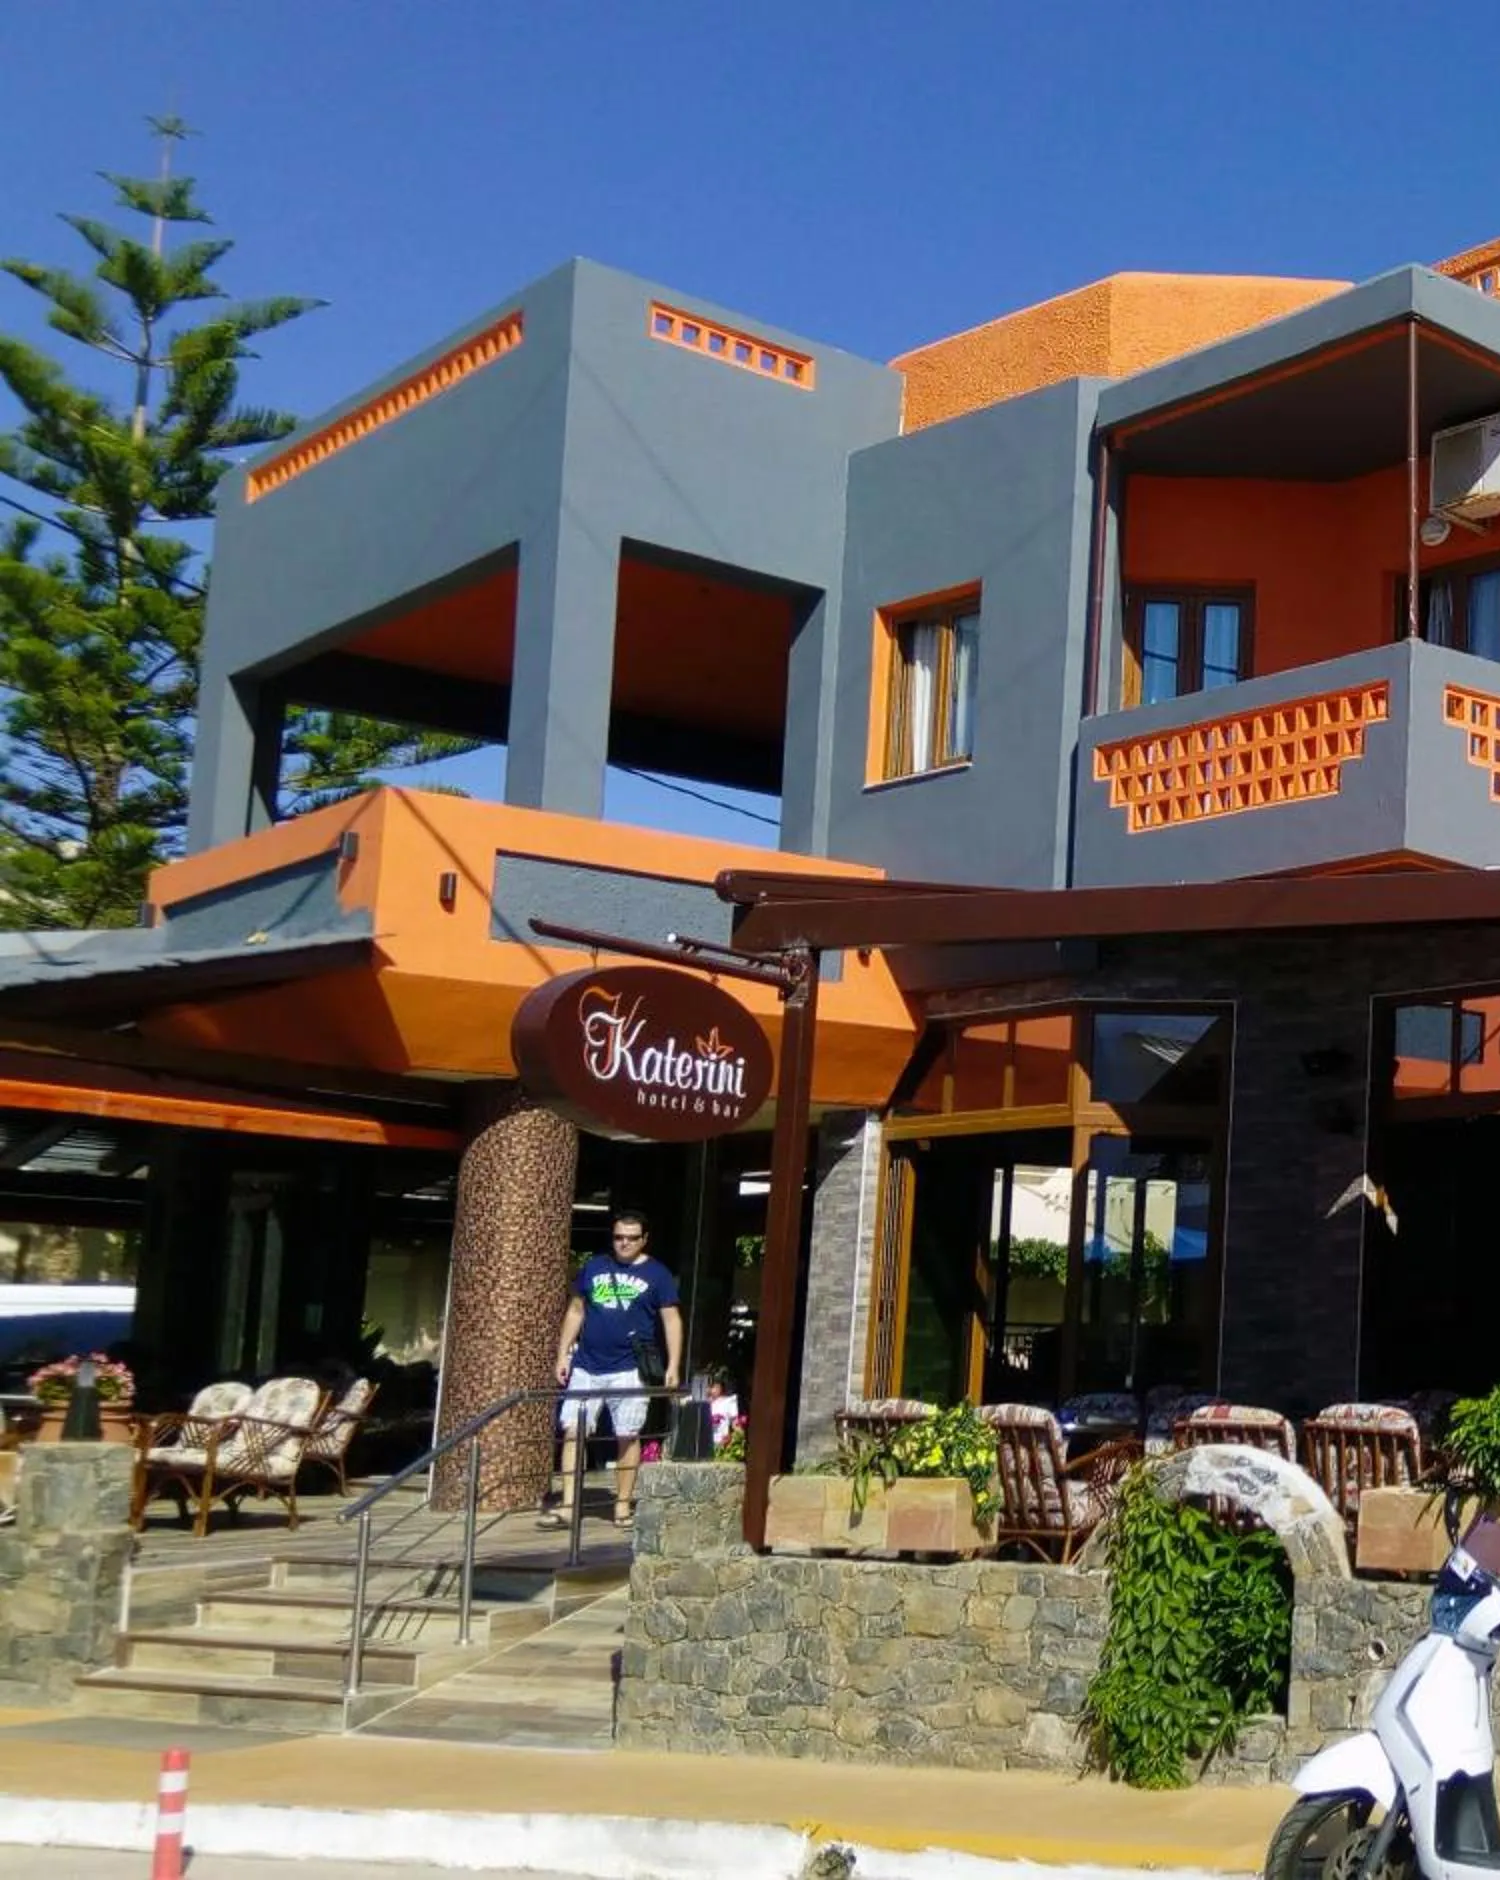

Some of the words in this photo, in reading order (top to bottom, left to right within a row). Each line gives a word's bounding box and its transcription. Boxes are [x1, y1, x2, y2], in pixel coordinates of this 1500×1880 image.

[585, 1011, 747, 1098] Katerini
[637, 1087, 686, 1111] hotel
[693, 1098, 705, 1113] &
[712, 1100, 740, 1118] bar
